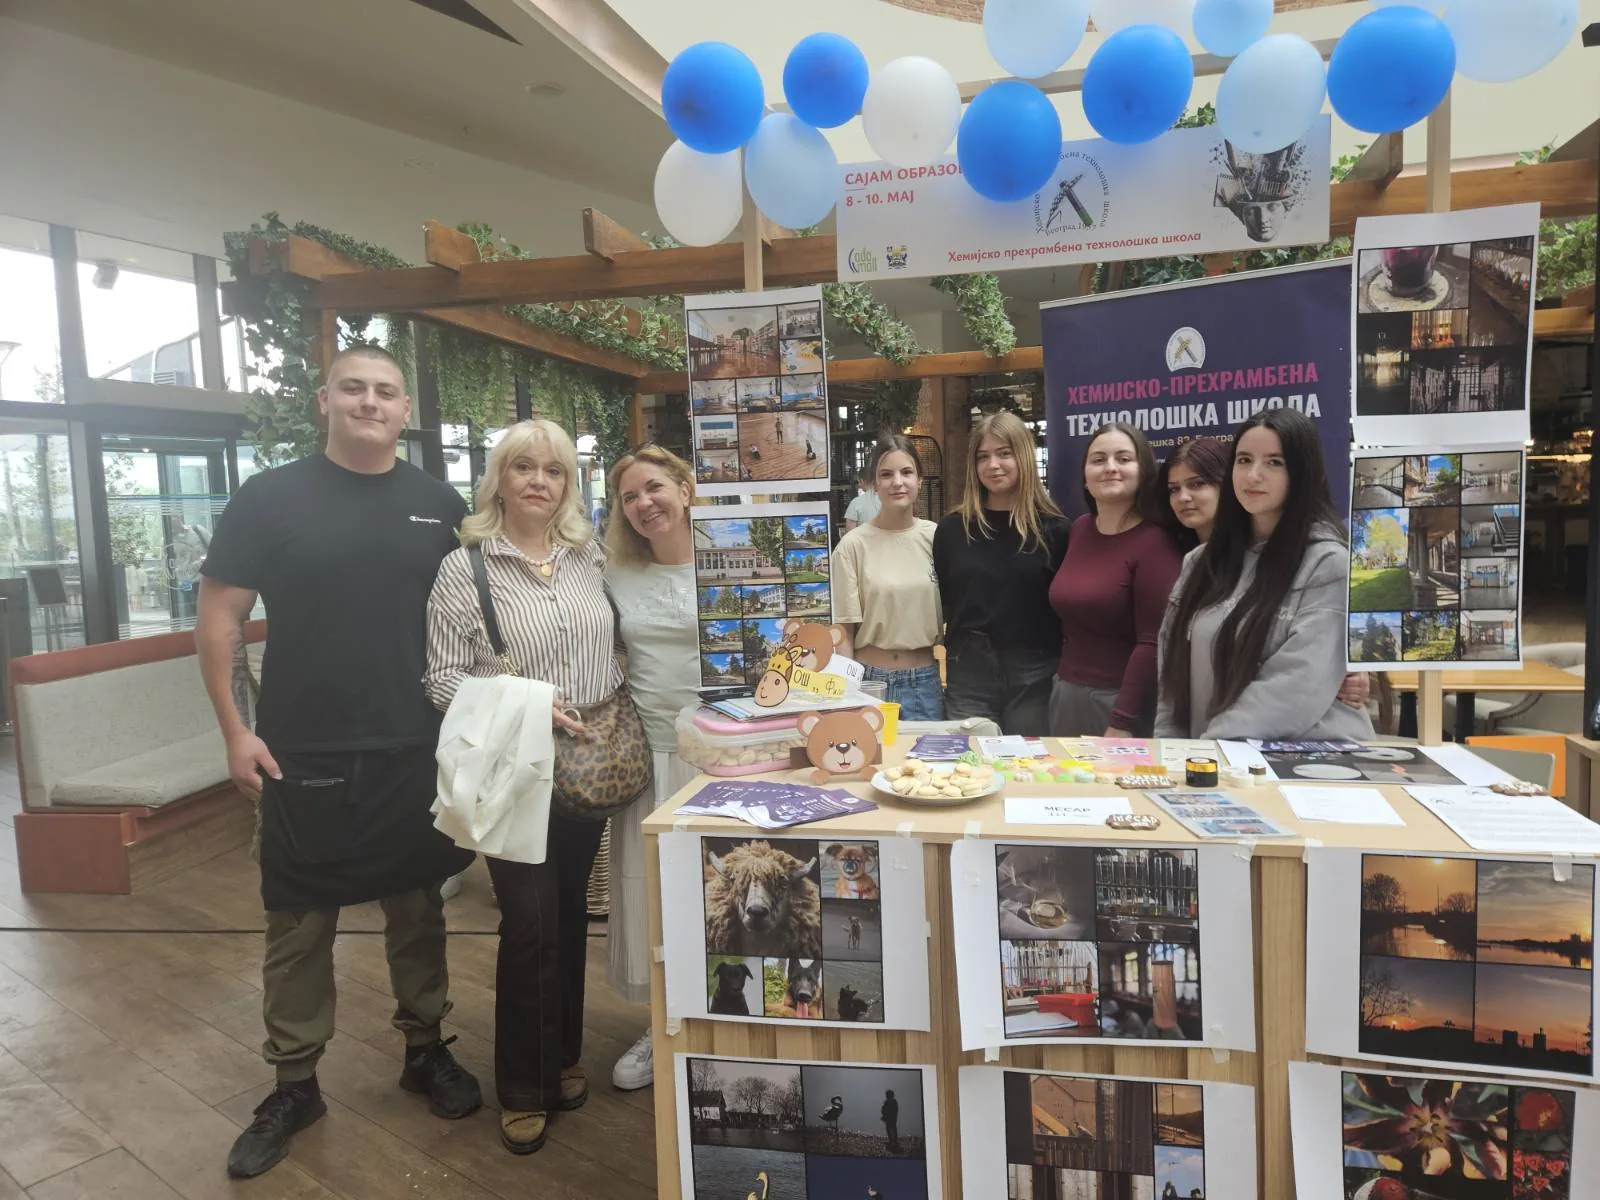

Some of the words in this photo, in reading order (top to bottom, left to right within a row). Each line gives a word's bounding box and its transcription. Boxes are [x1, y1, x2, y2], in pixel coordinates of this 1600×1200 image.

[845, 169, 893, 186] САЈАМ
[897, 163, 964, 181] ОБРАЗО
[846, 195, 854, 207] 8
[865, 192, 884, 205] 10.
[887, 190, 915, 204] МАЈ
[948, 249, 1001, 263] Хемијско
[1004, 242, 1082, 261] прехрамбена
[1087, 237, 1159, 250] технолошка
[1162, 233, 1201, 243] школа
[1067, 361, 1319, 405] ХЕМИЈСКО-ПРЕХРАМБЕНА
[793, 669, 811, 687] ОШ
